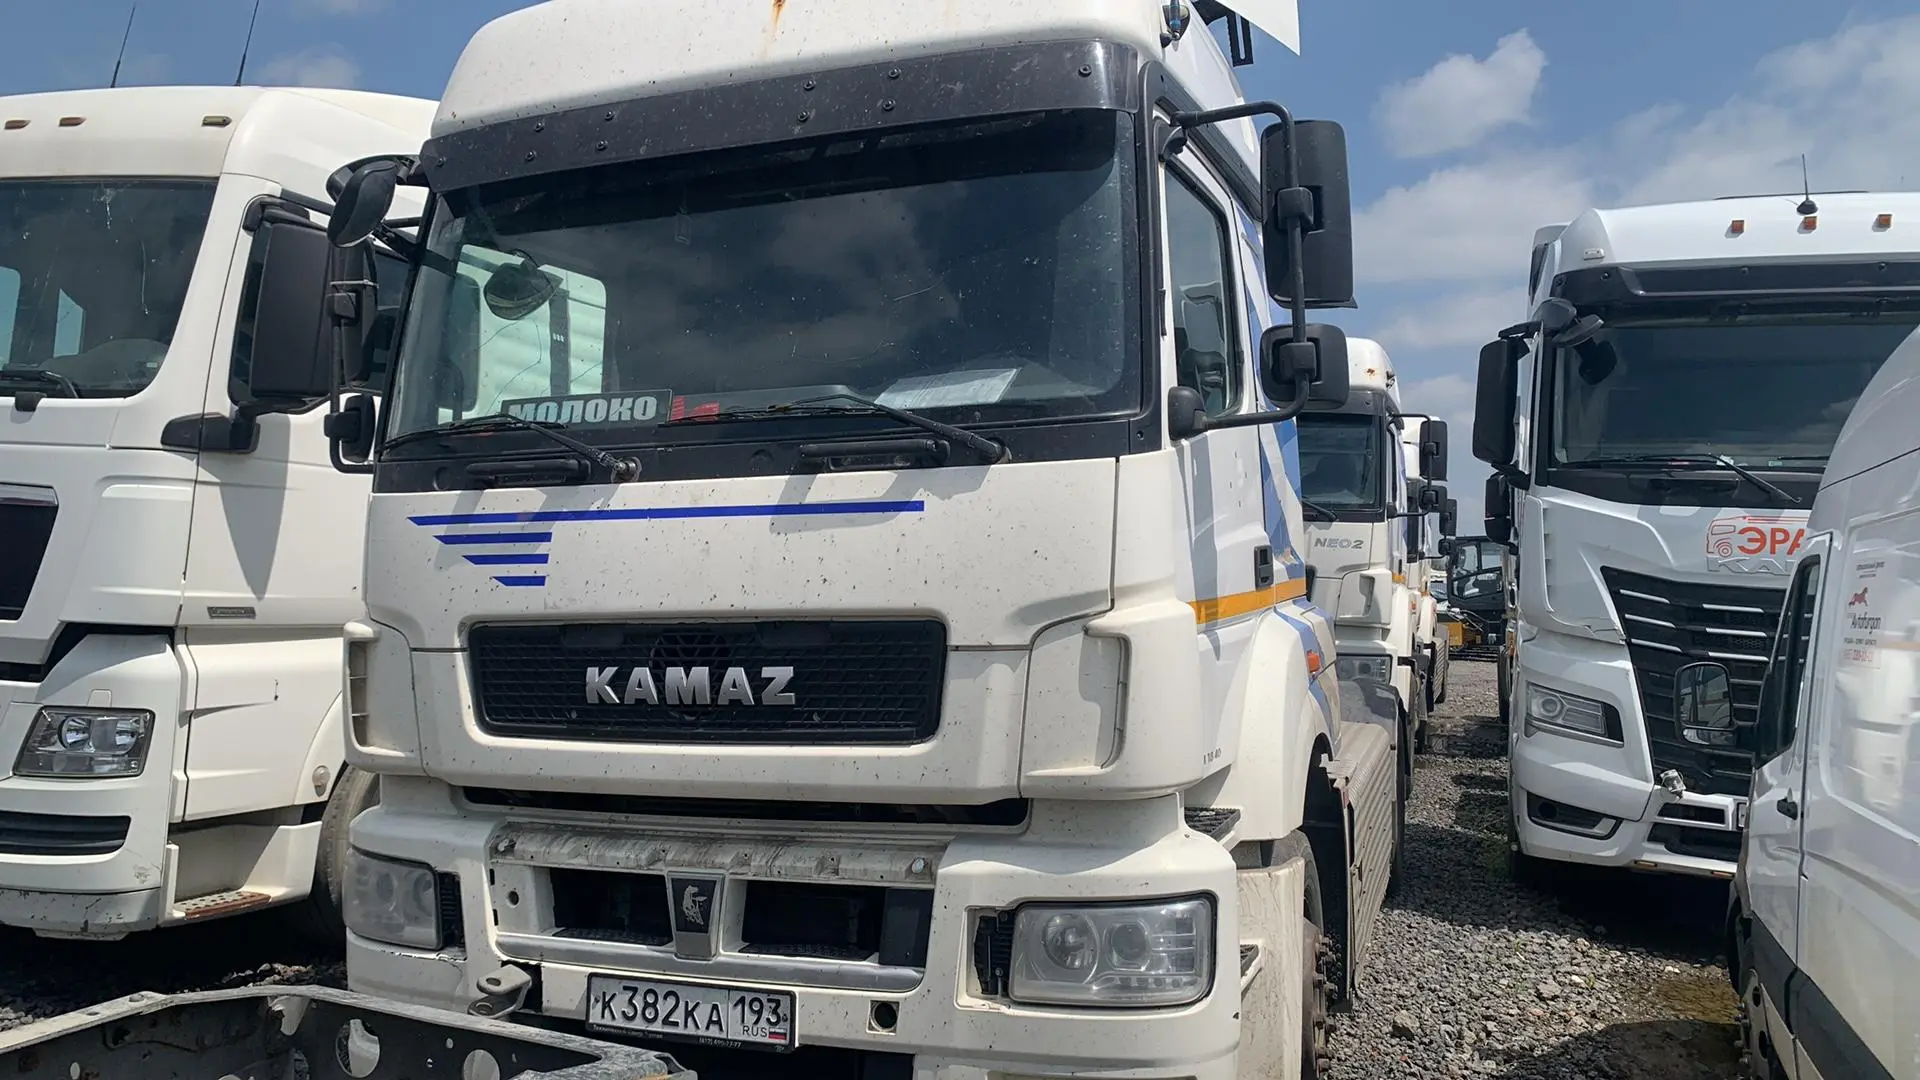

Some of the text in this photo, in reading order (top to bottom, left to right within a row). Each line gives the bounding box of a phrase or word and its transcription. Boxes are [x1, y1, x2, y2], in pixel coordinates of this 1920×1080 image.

[507, 395, 657, 425] МОЛОКО
[1313, 537, 1365, 550] NEO2
[585, 666, 796, 705] KAMAZ
[600, 985, 782, 1033] К382КА 193
[742, 1025, 768, 1038] RUS
